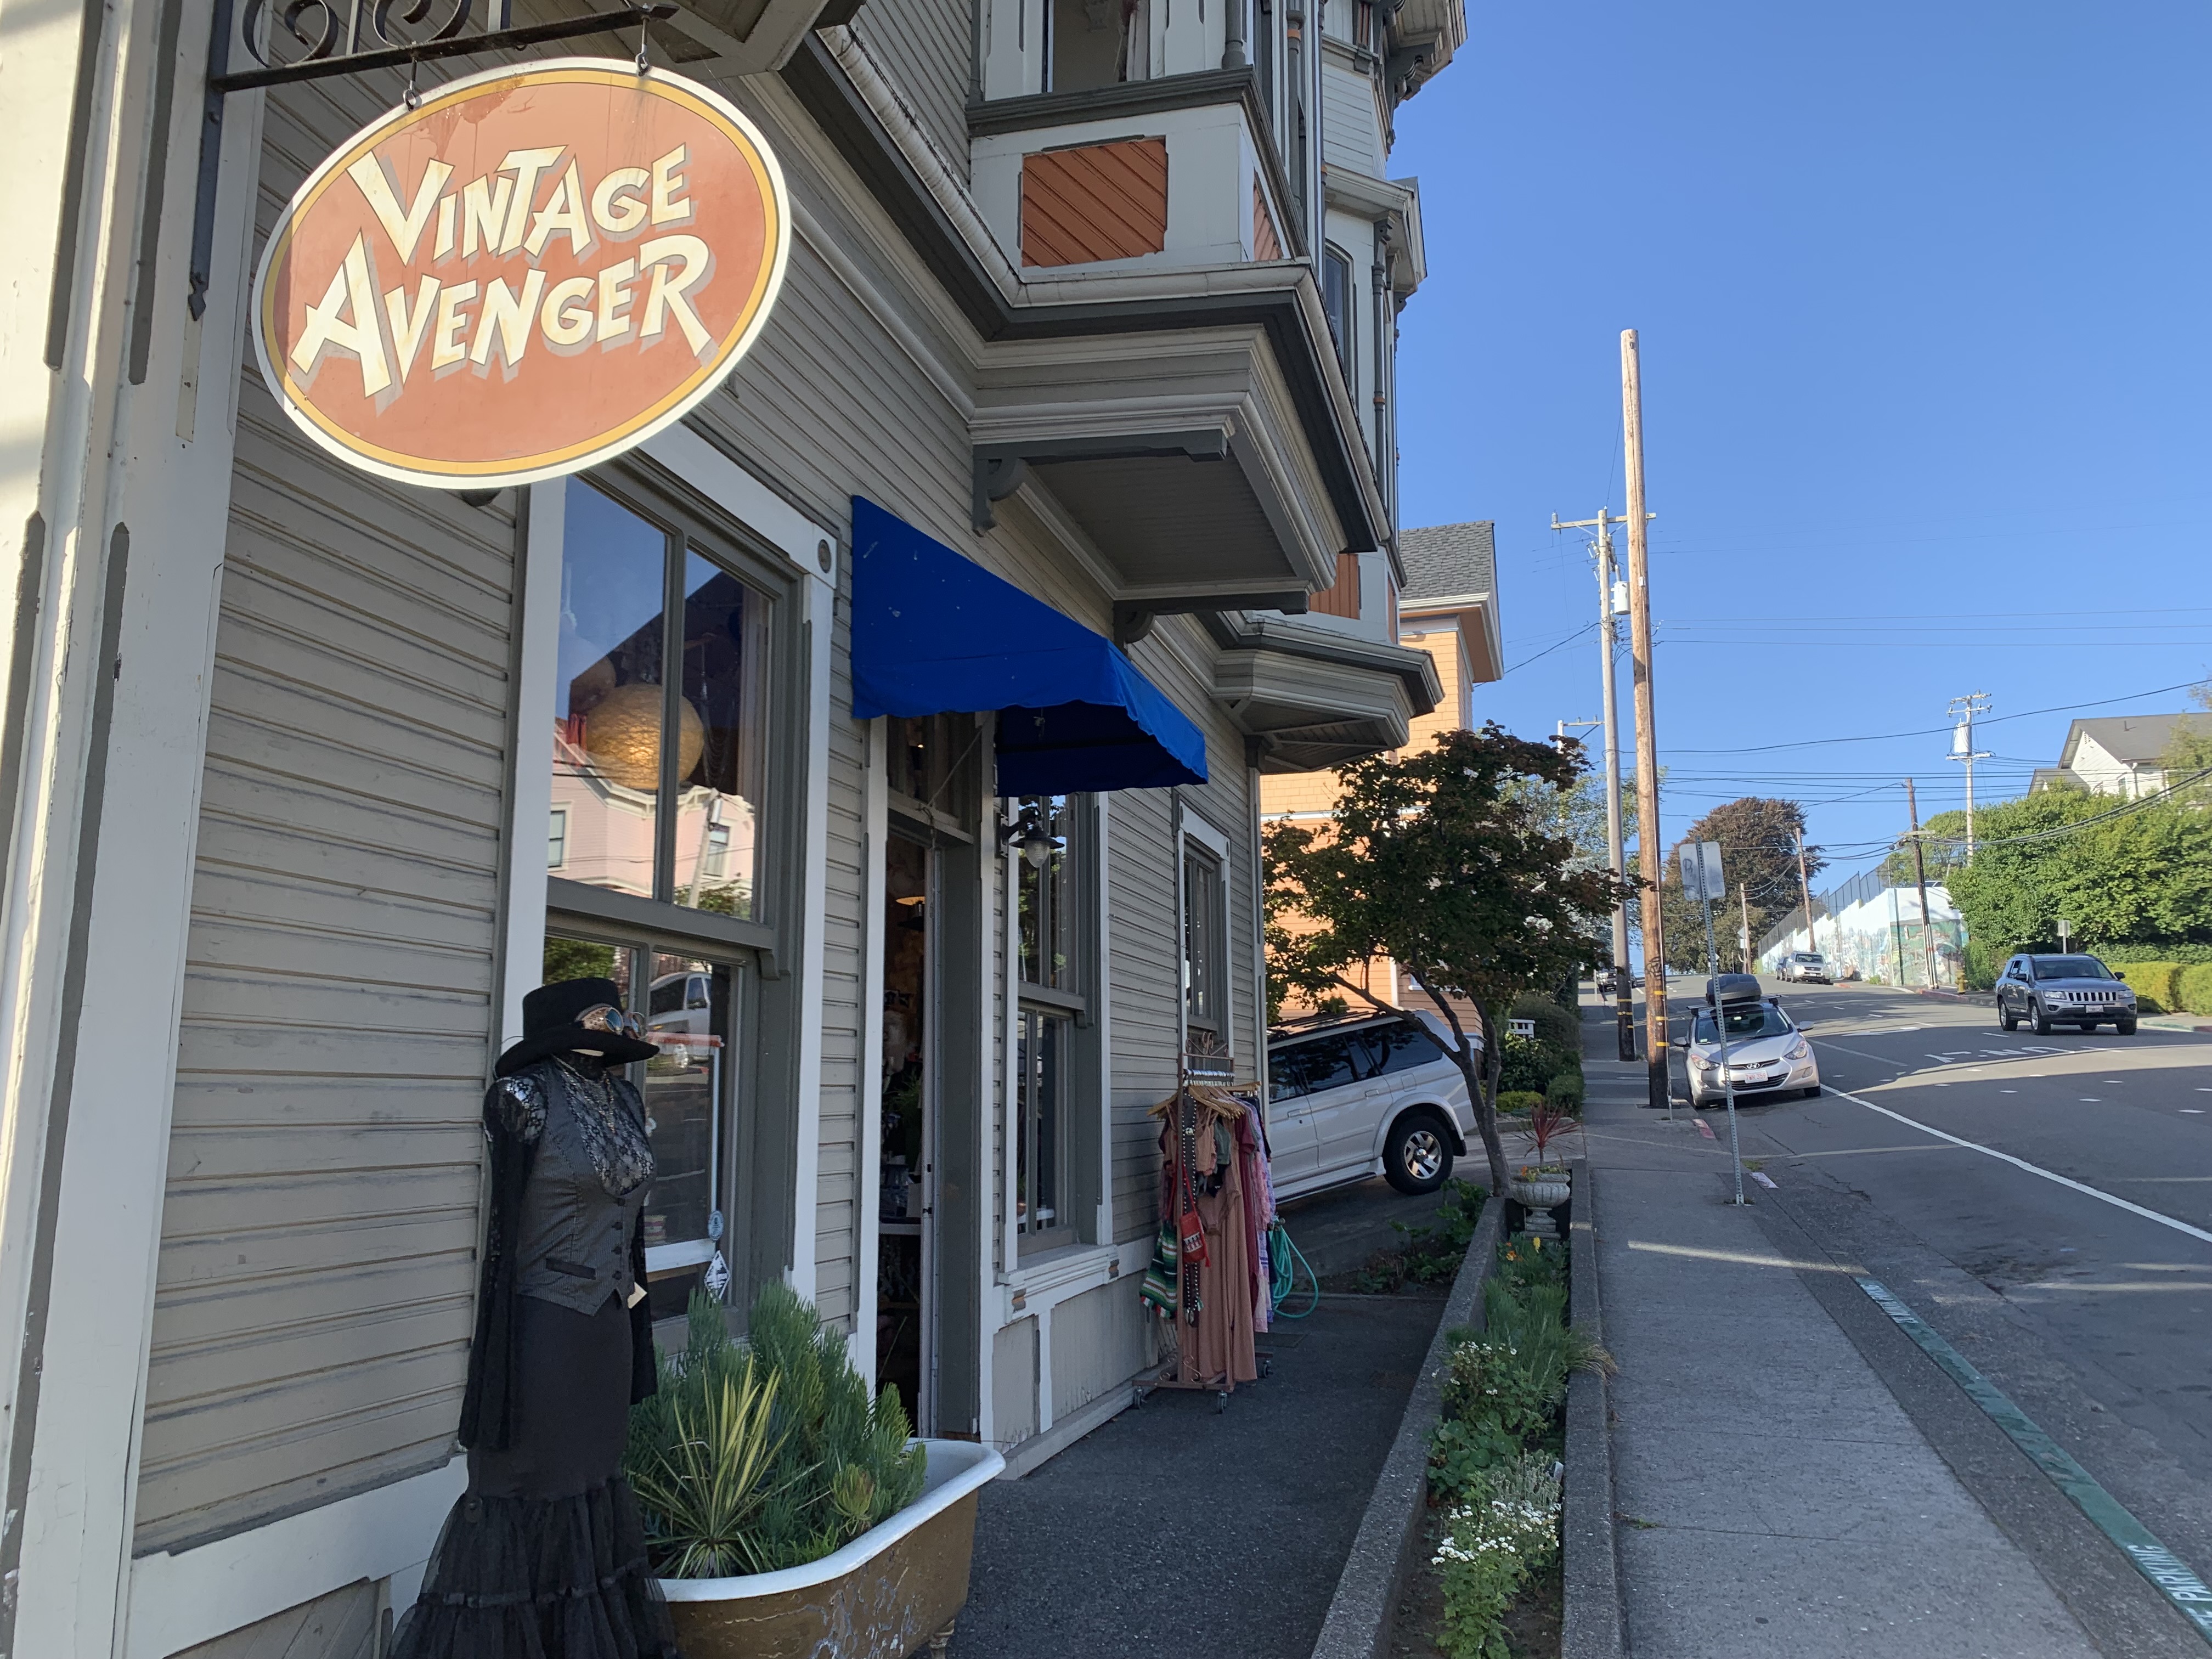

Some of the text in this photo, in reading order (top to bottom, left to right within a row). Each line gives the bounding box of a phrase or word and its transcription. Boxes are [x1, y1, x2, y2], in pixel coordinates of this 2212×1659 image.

[346, 142, 691, 266] VINTAGE
[290, 228, 712, 398] AVENGER
[2126, 1545, 2212, 1601] PARKING
